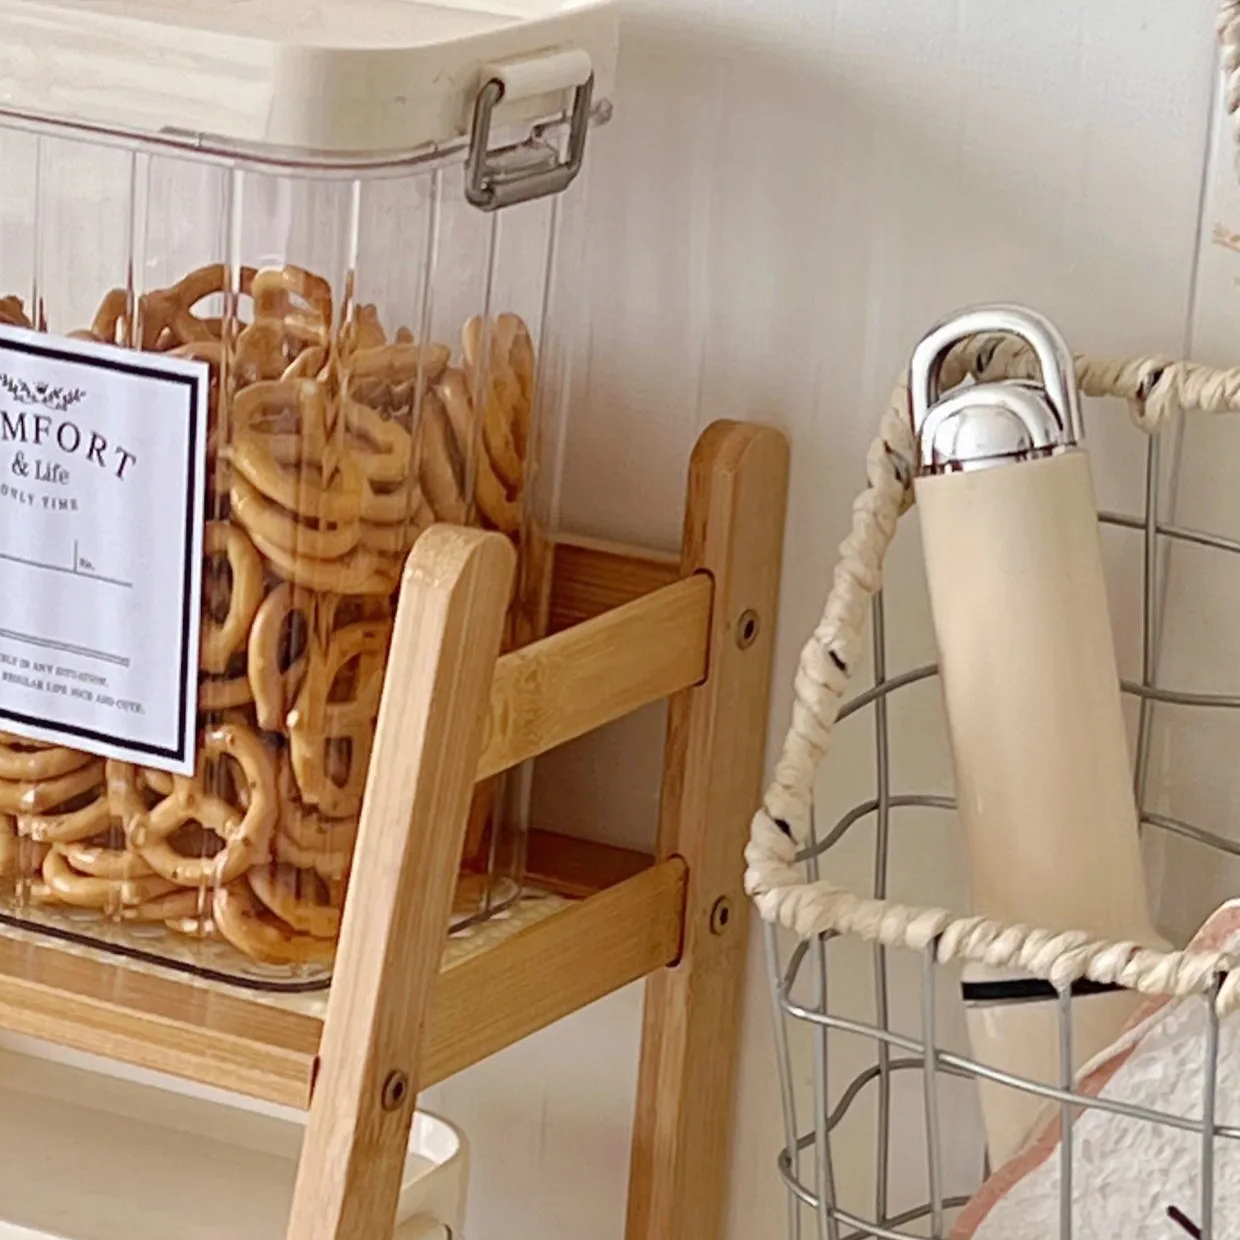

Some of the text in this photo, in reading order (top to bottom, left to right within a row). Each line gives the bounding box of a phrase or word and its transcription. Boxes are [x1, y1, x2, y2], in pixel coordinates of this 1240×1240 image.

[11, 450, 70, 485] & Life
[0, 483, 79, 511] ONLY TIME
